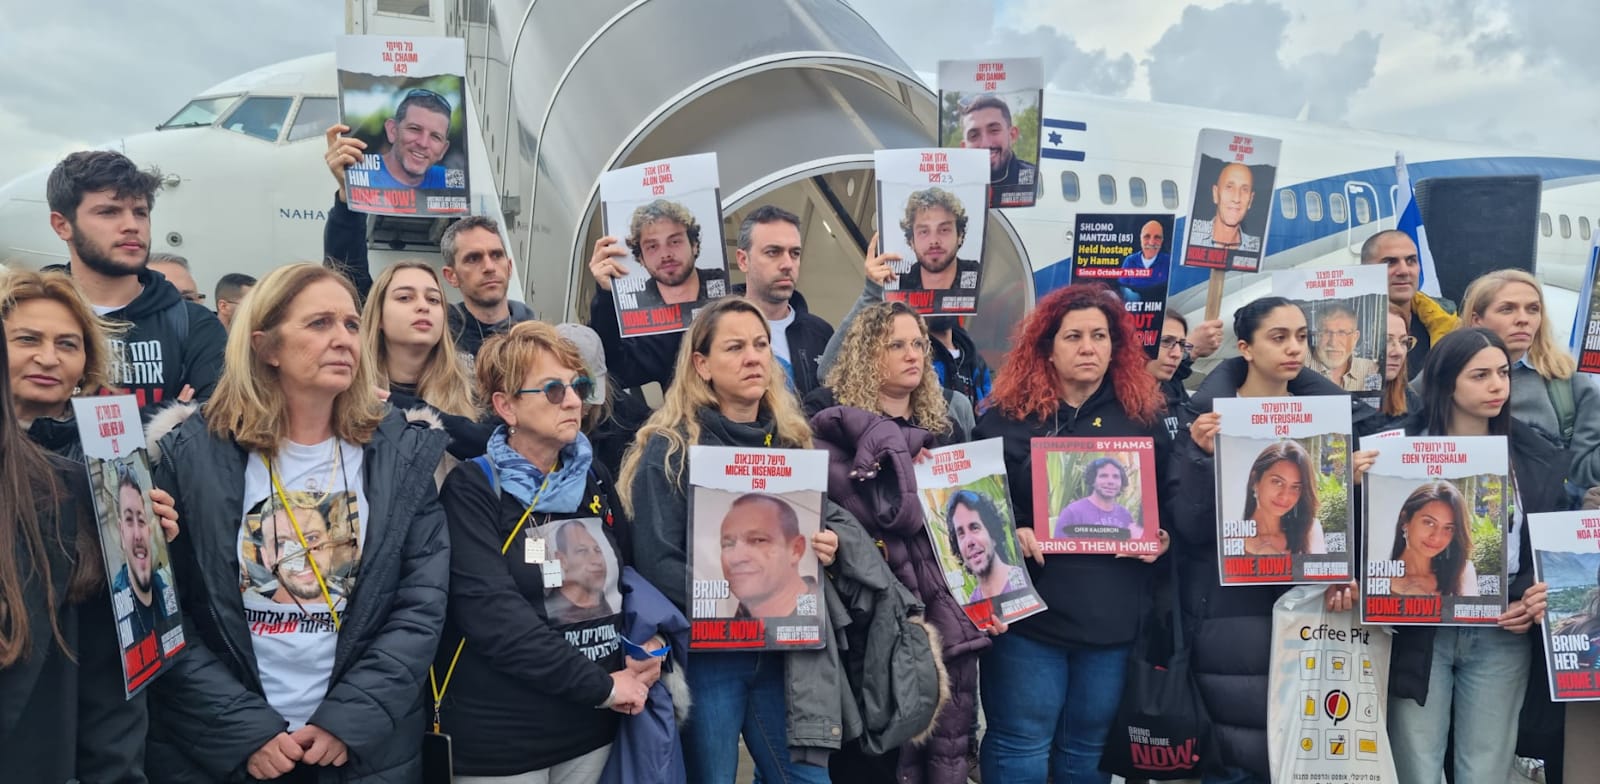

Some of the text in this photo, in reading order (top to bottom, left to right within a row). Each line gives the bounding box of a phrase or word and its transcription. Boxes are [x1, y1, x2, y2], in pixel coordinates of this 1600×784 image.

[382, 52, 418, 62] TAL CHAIMI
[394, 63, 408, 73] (42)
[348, 154, 381, 171] RING
[920, 163, 950, 172] ALON OHEL
[349, 170, 370, 187] HIM
[642, 174, 674, 186] ALON OHEL
[942, 175, 954, 184] 23
[652, 185, 665, 195] (22)
[351, 188, 416, 207] HOME NOW!
[280, 208, 326, 221] NAHA
[1080, 223, 1114, 232] SHLOMO
[1079, 234, 1134, 244] MANTZUR (85)
[1078, 245, 1134, 257] Held hostage
[884, 260, 912, 274] RING
[1078, 256, 1120, 267] by Hamas
[1097, 269, 1123, 277] October
[615, 277, 647, 293] BRING
[1306, 278, 1354, 289] YORAM METZGER
[618, 294, 639, 310] HIM
[909, 289, 934, 307] NOW!
[1125, 302, 1162, 312] GET HIM
[622, 310, 649, 327] HOME
[651, 304, 681, 324] NOW!
[1262, 402, 1302, 413] עדן ירושלמי
[1252, 413, 1313, 425] EDEN YERUSHALMI
[1275, 425, 1289, 436] (24)
[1032, 441, 1153, 449] KIDNAPPED BY HAMAS
[1413, 442, 1456, 453] עדן ירושלמי
[735, 454, 786, 466] מישל ניסנבאום
[1402, 454, 1468, 464] EDEN YERUSHALMI
[726, 465, 792, 477] MICHEL NISENBAUM
[932, 459, 972, 476] OFER KALDERON
[1427, 465, 1442, 476] (24)
[752, 478, 766, 490] (59)
[1223, 520, 1257, 538] BRING
[1576, 529, 1592, 540] NOA
[1038, 541, 1158, 552] BRING THEM HOME
[1224, 538, 1245, 556] HER
[1224, 554, 1292, 575] HOME NOW!
[1368, 560, 1405, 578] BRING
[693, 580, 730, 599] BRING
[1367, 578, 1392, 595] HER
[692, 600, 716, 618] HIM
[1366, 595, 1441, 615] HOME NOW!
[692, 617, 765, 640] HOME NOW!
[565, 631, 581, 647] את
[1552, 635, 1590, 652] BRING
[1554, 653, 1580, 670] HER
[1557, 673, 1592, 690] HOME
[1128, 726, 1152, 737] BRING
[1129, 734, 1170, 746] THEM HOME
[1130, 738, 1200, 767] NOW!
